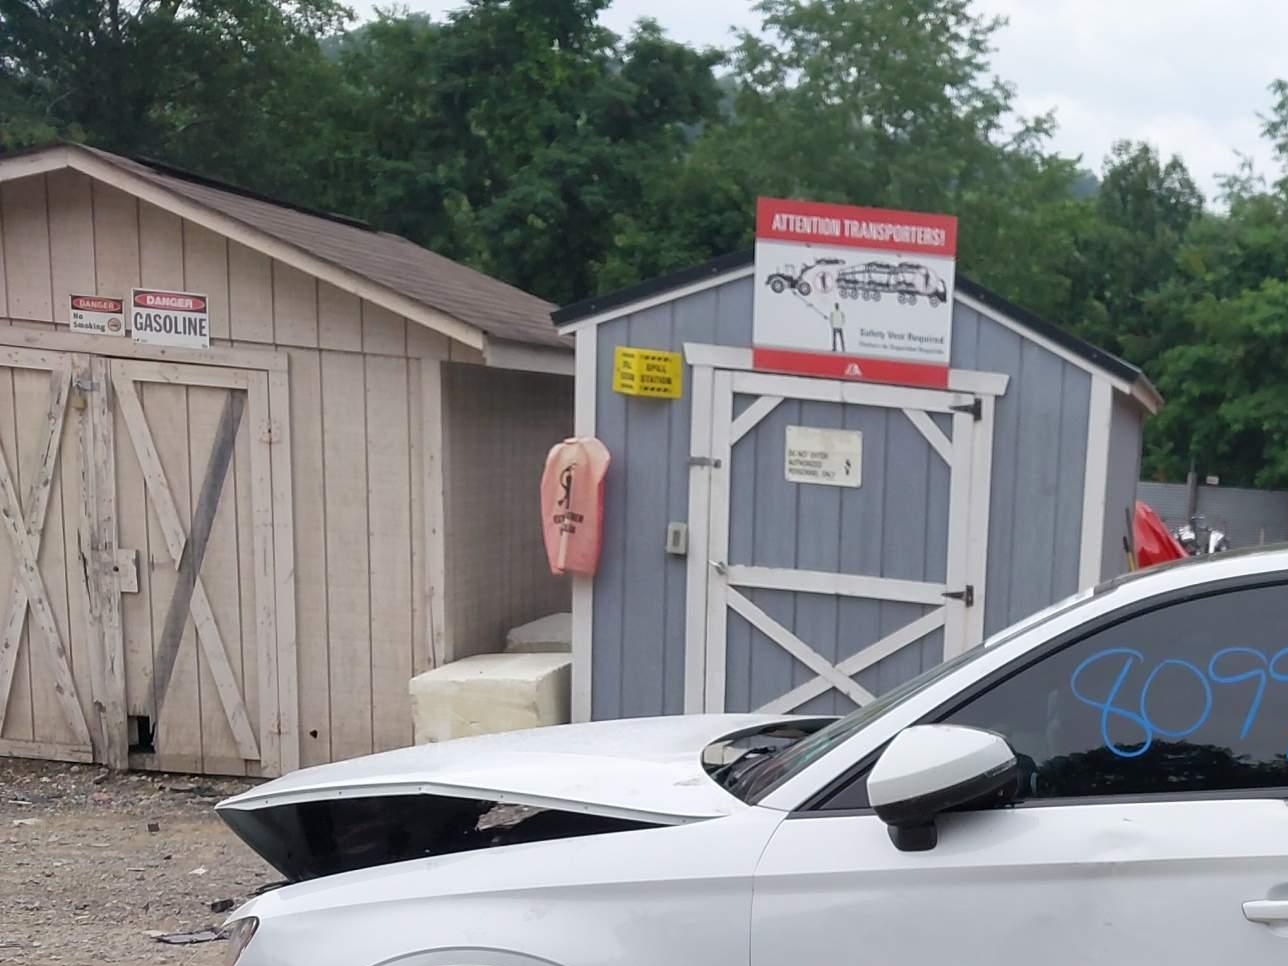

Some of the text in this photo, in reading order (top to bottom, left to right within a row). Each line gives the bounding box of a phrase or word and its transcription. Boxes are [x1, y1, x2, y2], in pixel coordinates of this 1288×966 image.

[772, 213, 946, 247] ATTENTION TRANSPORTERS!
[79, 299, 115, 310] DANGER
[146, 295, 193, 309] DANGER
[73, 312, 84, 320] No
[73, 321, 106, 333] Smoking
[133, 312, 208, 337] GASOLINE
